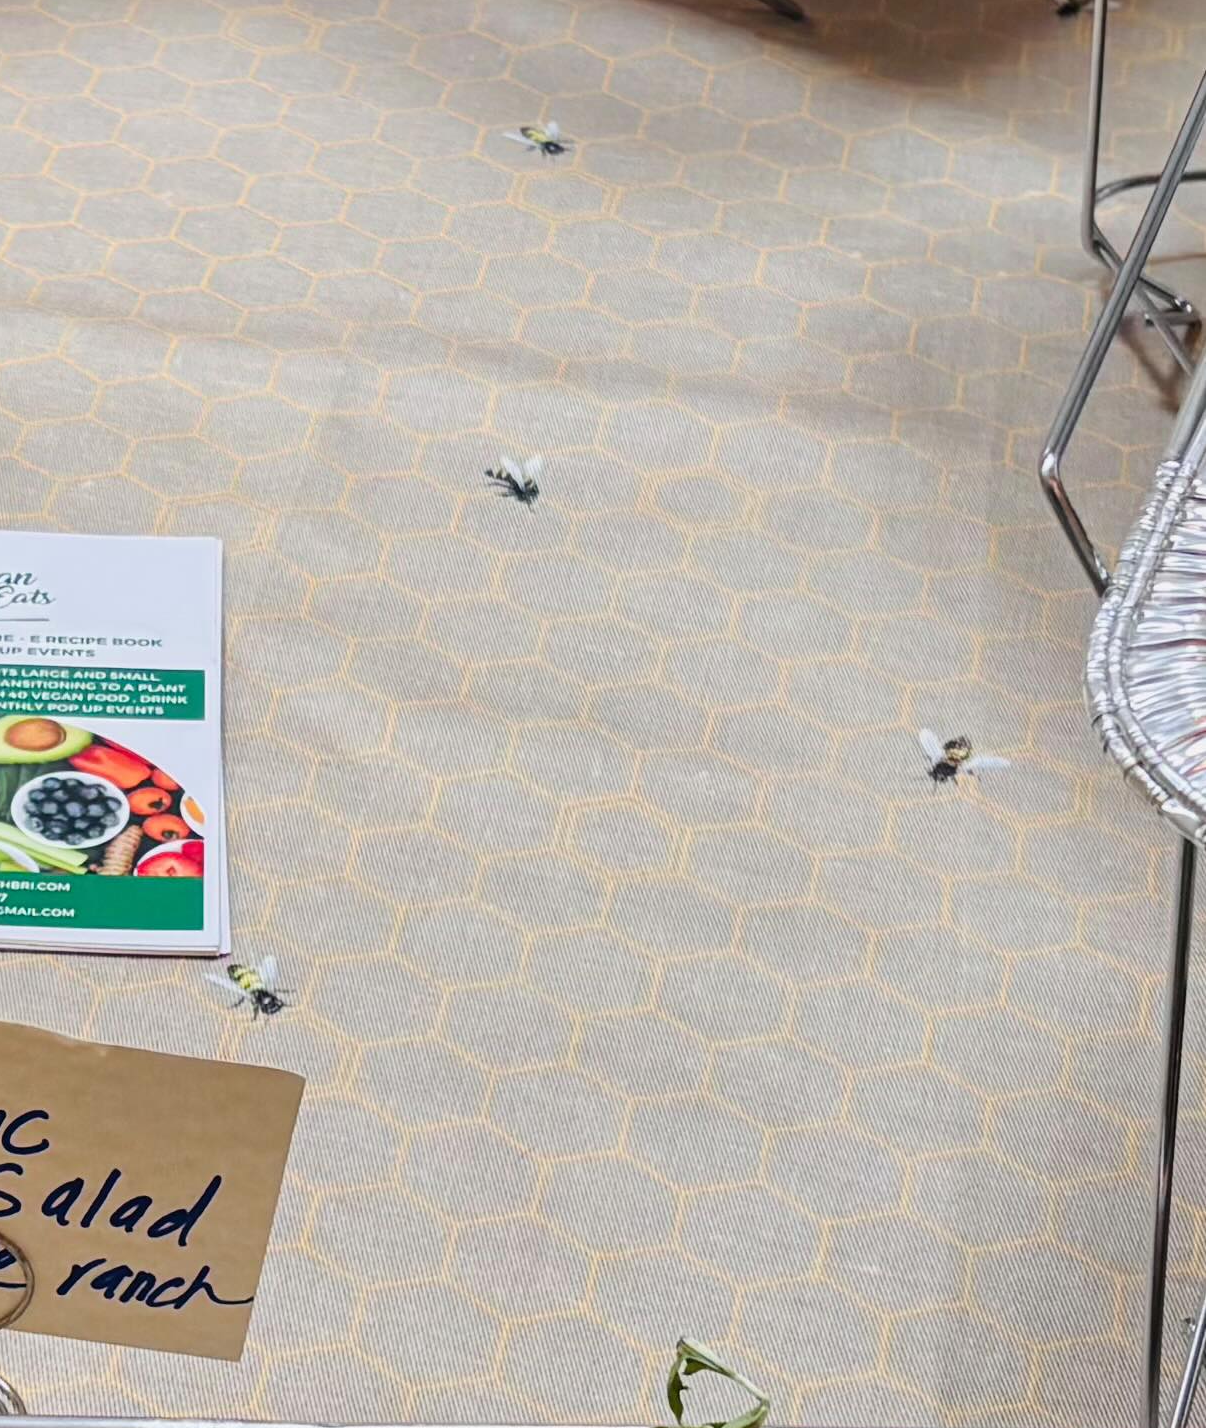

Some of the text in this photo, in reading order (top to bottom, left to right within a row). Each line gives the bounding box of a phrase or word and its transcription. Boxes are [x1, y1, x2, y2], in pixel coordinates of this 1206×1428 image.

[30, 635, 40, 644] E
[46, 636, 107, 646] RECIPE
[112, 637, 163, 647] BOOK
[0, 647, 22, 655] UP
[28, 648, 95, 657] EVENTS
[21, 669, 70, 678] LARGE
[73, 670, 106, 680] AND
[110, 671, 161, 681] SMALL
[100, 682, 120, 691] TO
[123, 683, 135, 692] A
[138, 684, 186, 693] PLANT
[31, 691, 84, 701] VEGAN
[87, 693, 129, 703] FOOD
[140, 694, 188, 704] DRINK
[47, 703, 79, 712] POP
[82, 704, 103, 713] UP
[106, 705, 164, 715] EVENTS
[56, 1254, 255, 1311] ranch
